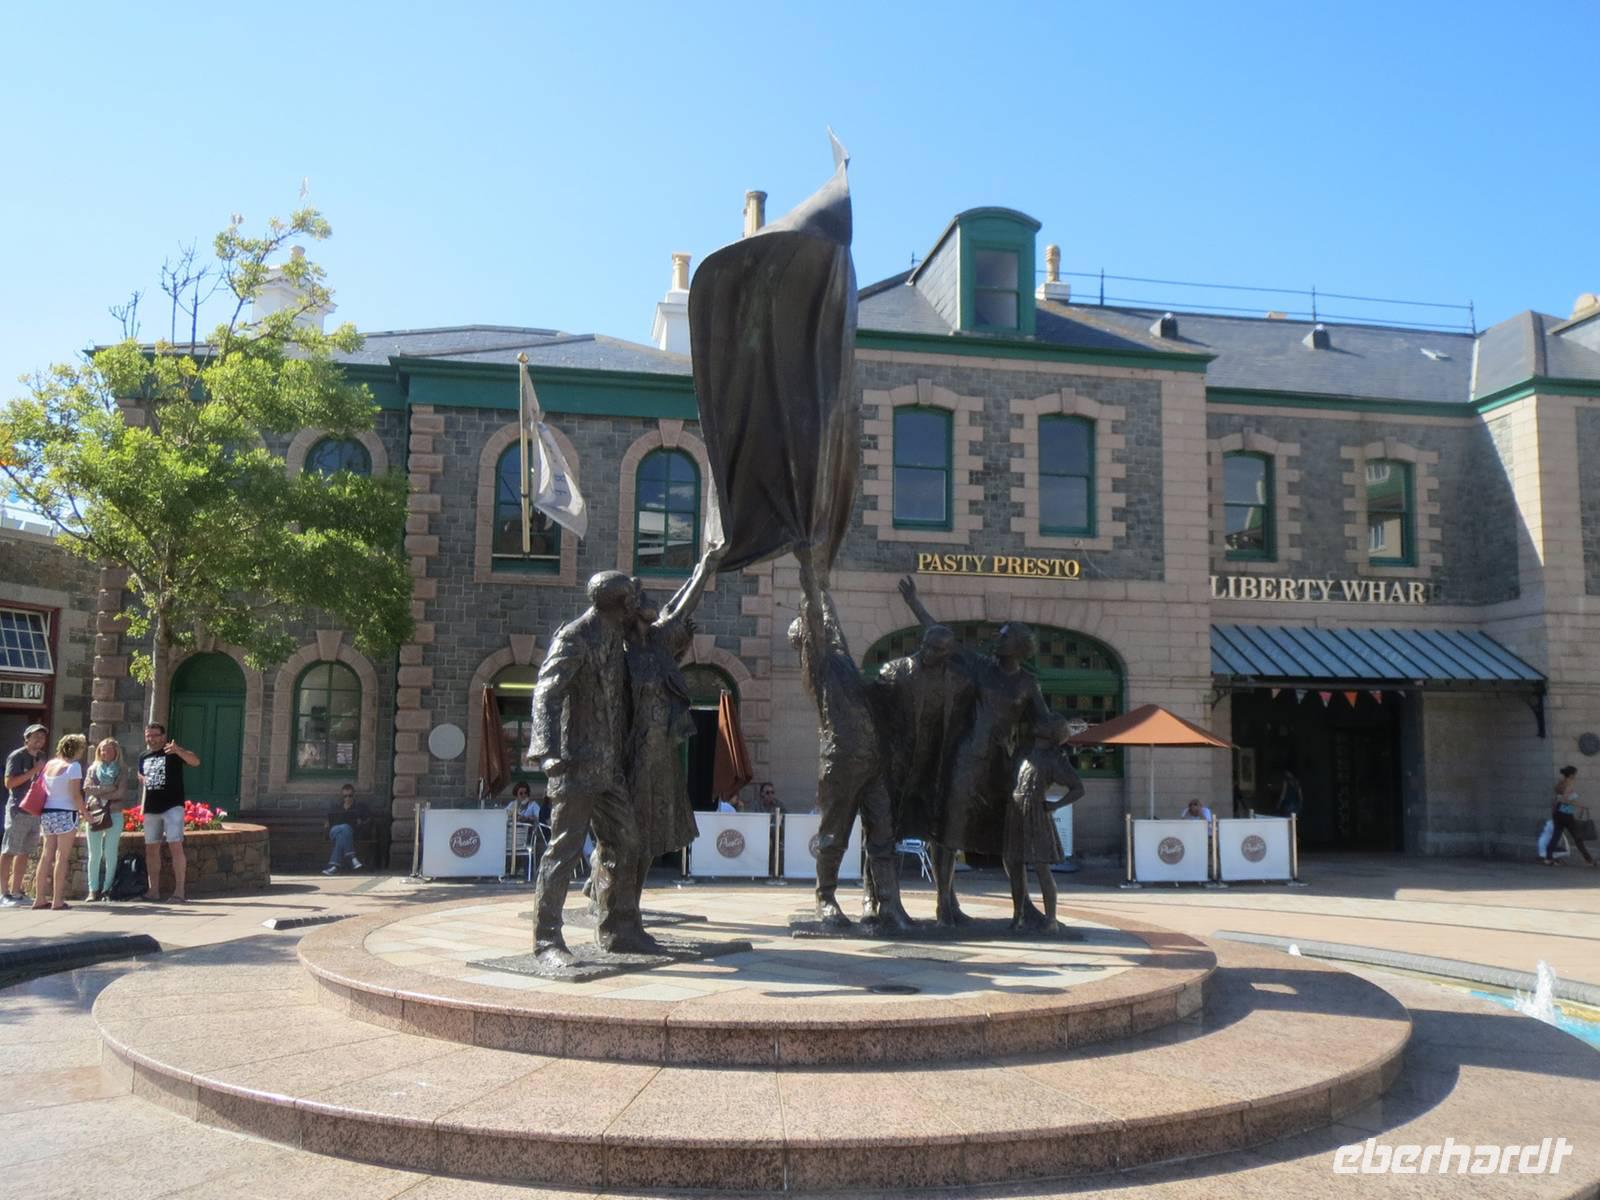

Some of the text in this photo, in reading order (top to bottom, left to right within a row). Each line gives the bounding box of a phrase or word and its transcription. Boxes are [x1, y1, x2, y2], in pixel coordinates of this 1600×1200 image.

[917, 553, 1080, 578] PASTY PRESTO
[1210, 576, 1334, 601] LIBERTY
